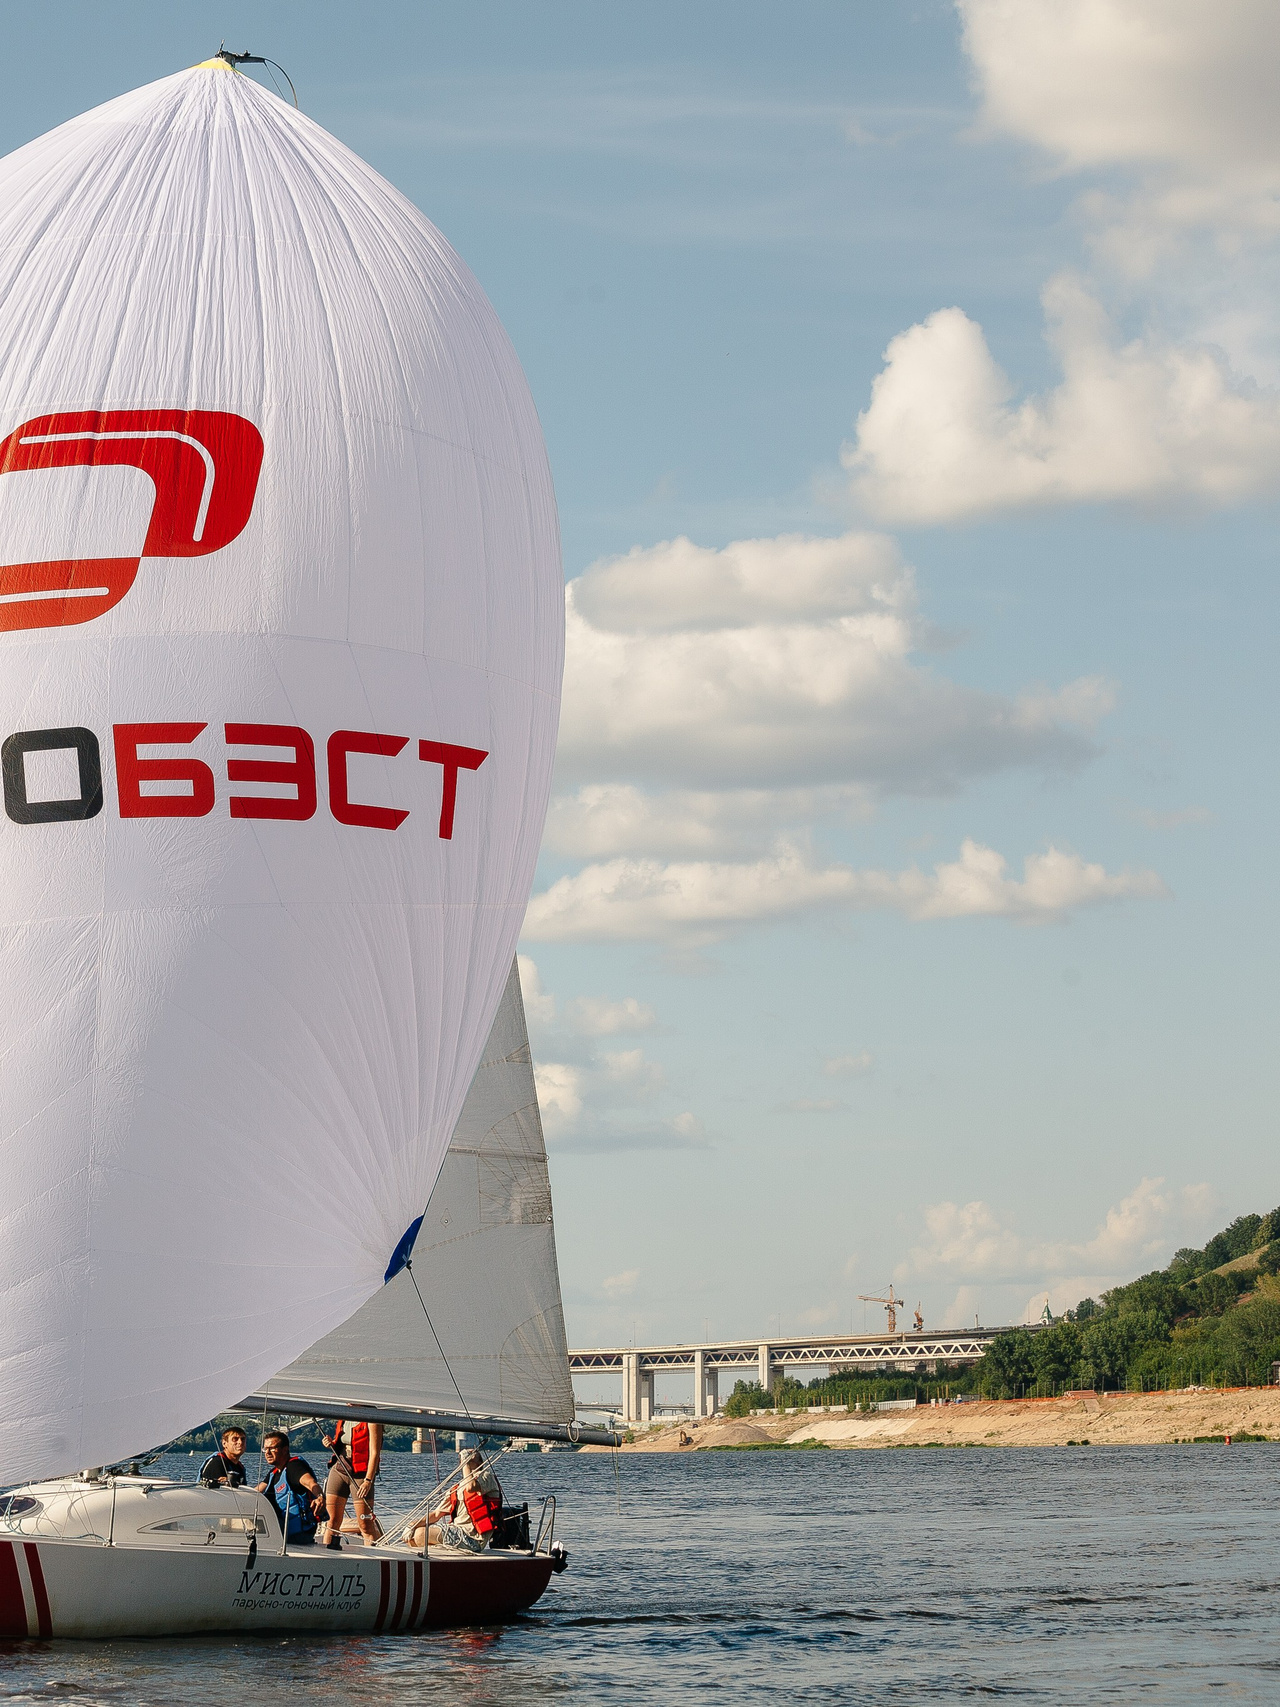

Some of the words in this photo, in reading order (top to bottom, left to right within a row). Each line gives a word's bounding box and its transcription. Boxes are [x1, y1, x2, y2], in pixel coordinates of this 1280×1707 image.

[236, 1571, 366, 1597] МИСТРАЛЬ
[231, 1598, 336, 1611] парусно-гоночный
[337, 1599, 362, 1612] клуб
